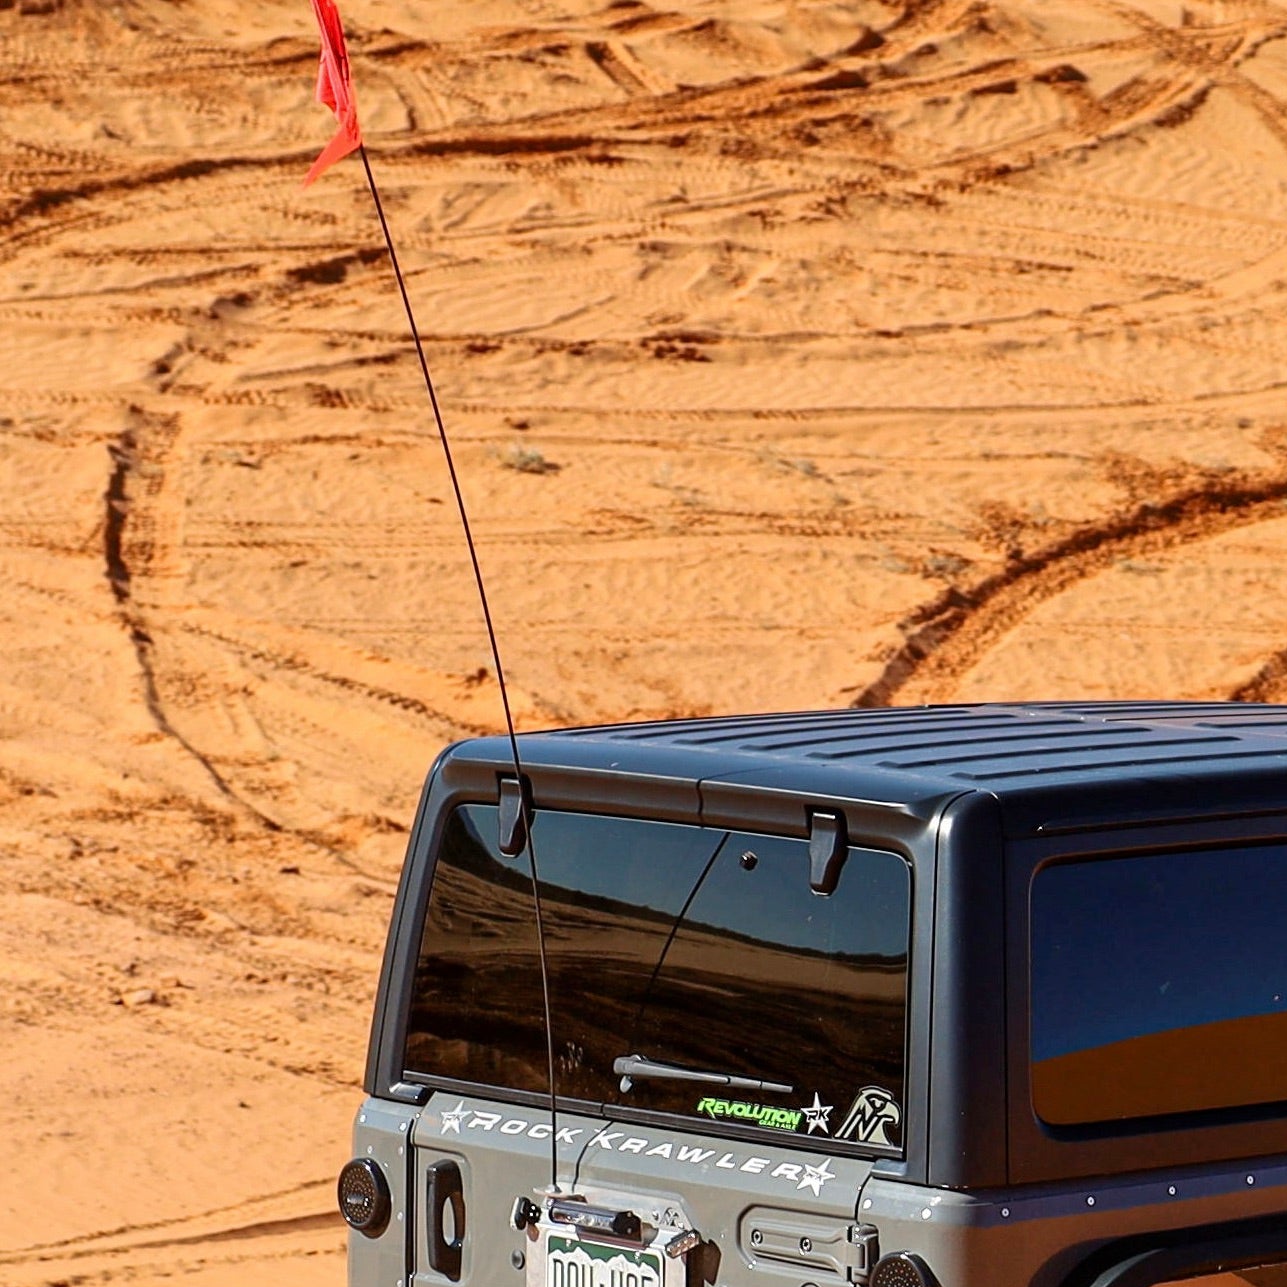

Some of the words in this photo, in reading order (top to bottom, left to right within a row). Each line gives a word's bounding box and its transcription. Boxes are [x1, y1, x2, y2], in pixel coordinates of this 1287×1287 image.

[697, 1097, 801, 1125] REVOLUTION
[467, 1110, 583, 1144] ROCK
[588, 1128, 803, 1182] KRAWLER
